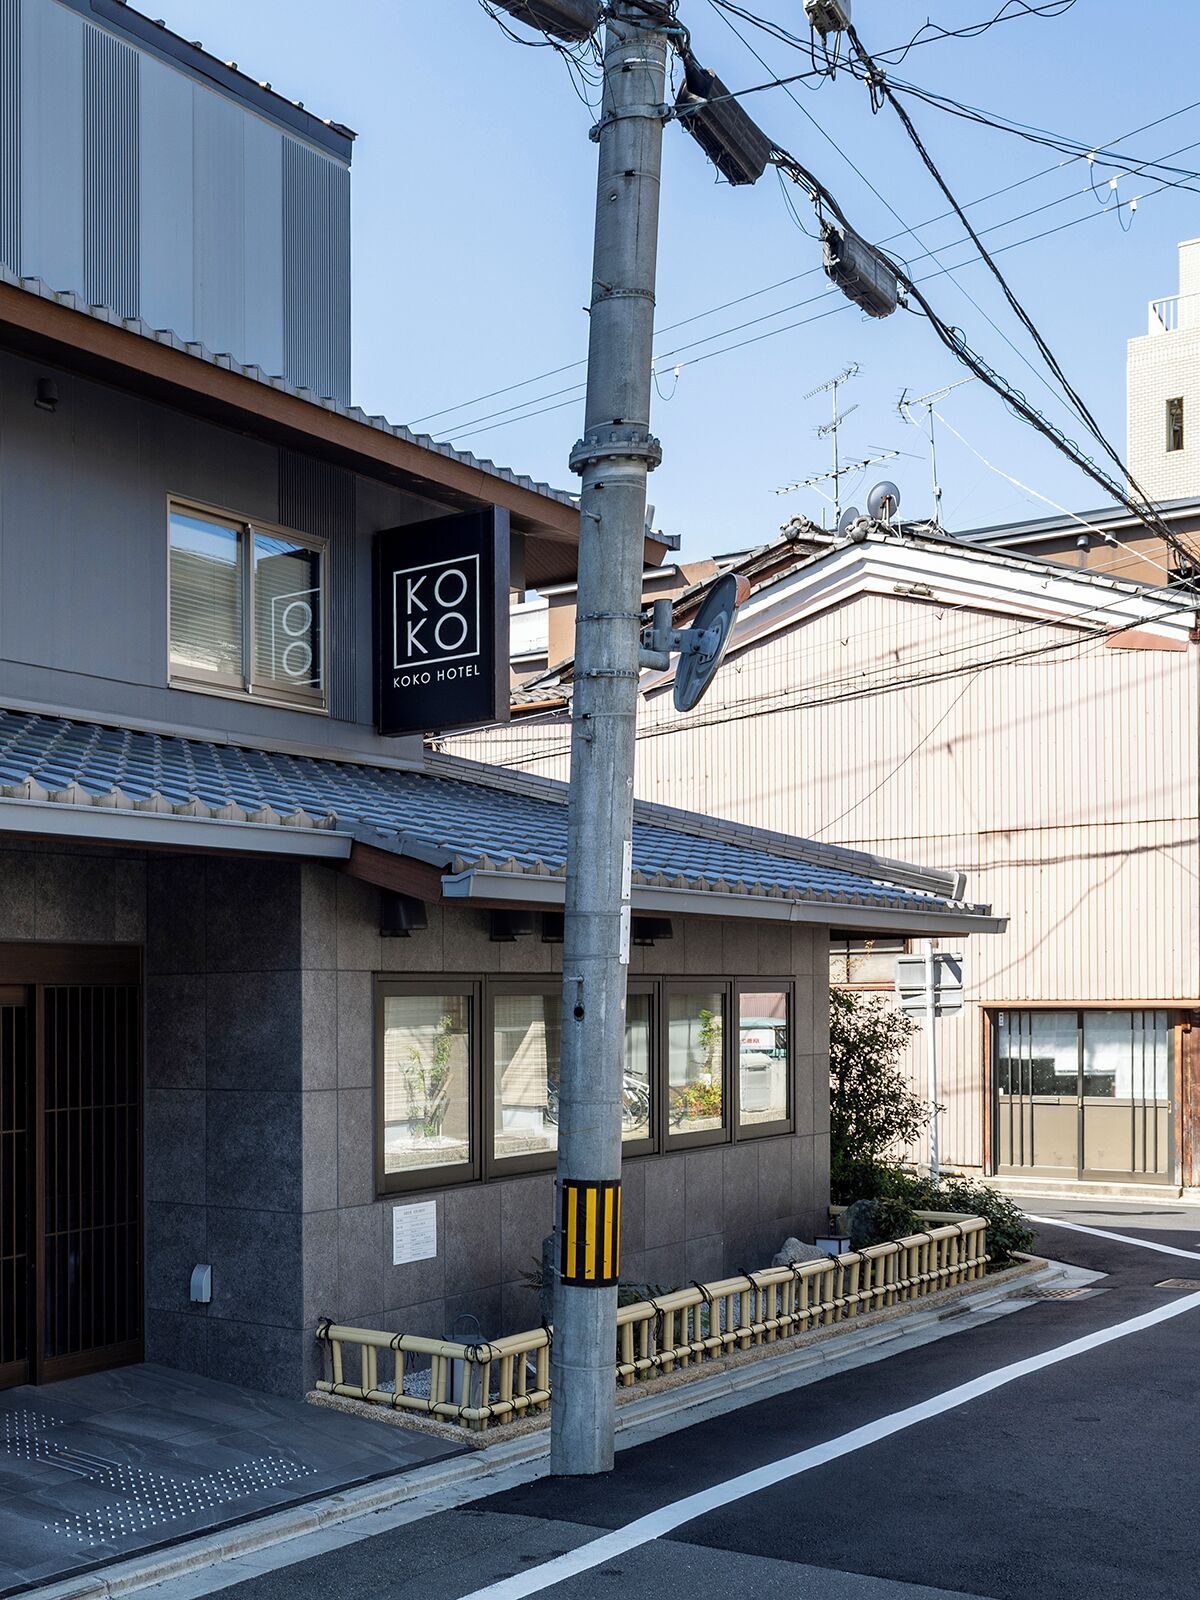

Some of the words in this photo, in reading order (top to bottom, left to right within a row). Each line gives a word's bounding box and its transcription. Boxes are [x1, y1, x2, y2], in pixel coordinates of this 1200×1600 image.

[406, 568, 468, 615] KO
[406, 611, 468, 657] KO
[393, 671, 431, 688] KOKO
[436, 664, 481, 682] HOTEL
